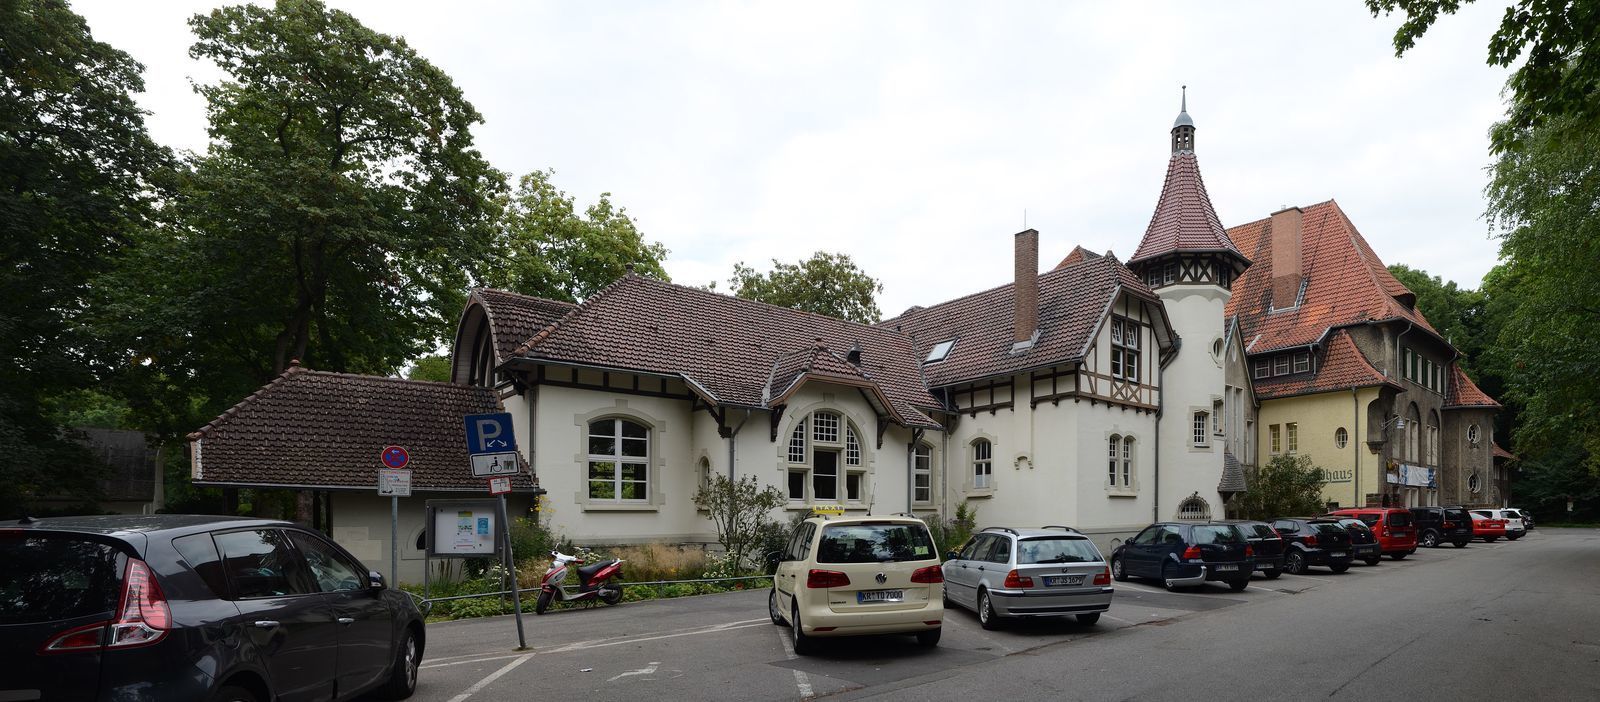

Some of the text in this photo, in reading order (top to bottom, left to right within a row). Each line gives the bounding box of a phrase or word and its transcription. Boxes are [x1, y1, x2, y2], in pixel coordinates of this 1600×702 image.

[476, 419, 502, 451] P
[863, 592, 871, 600] KR
[886, 591, 903, 599] 7000
